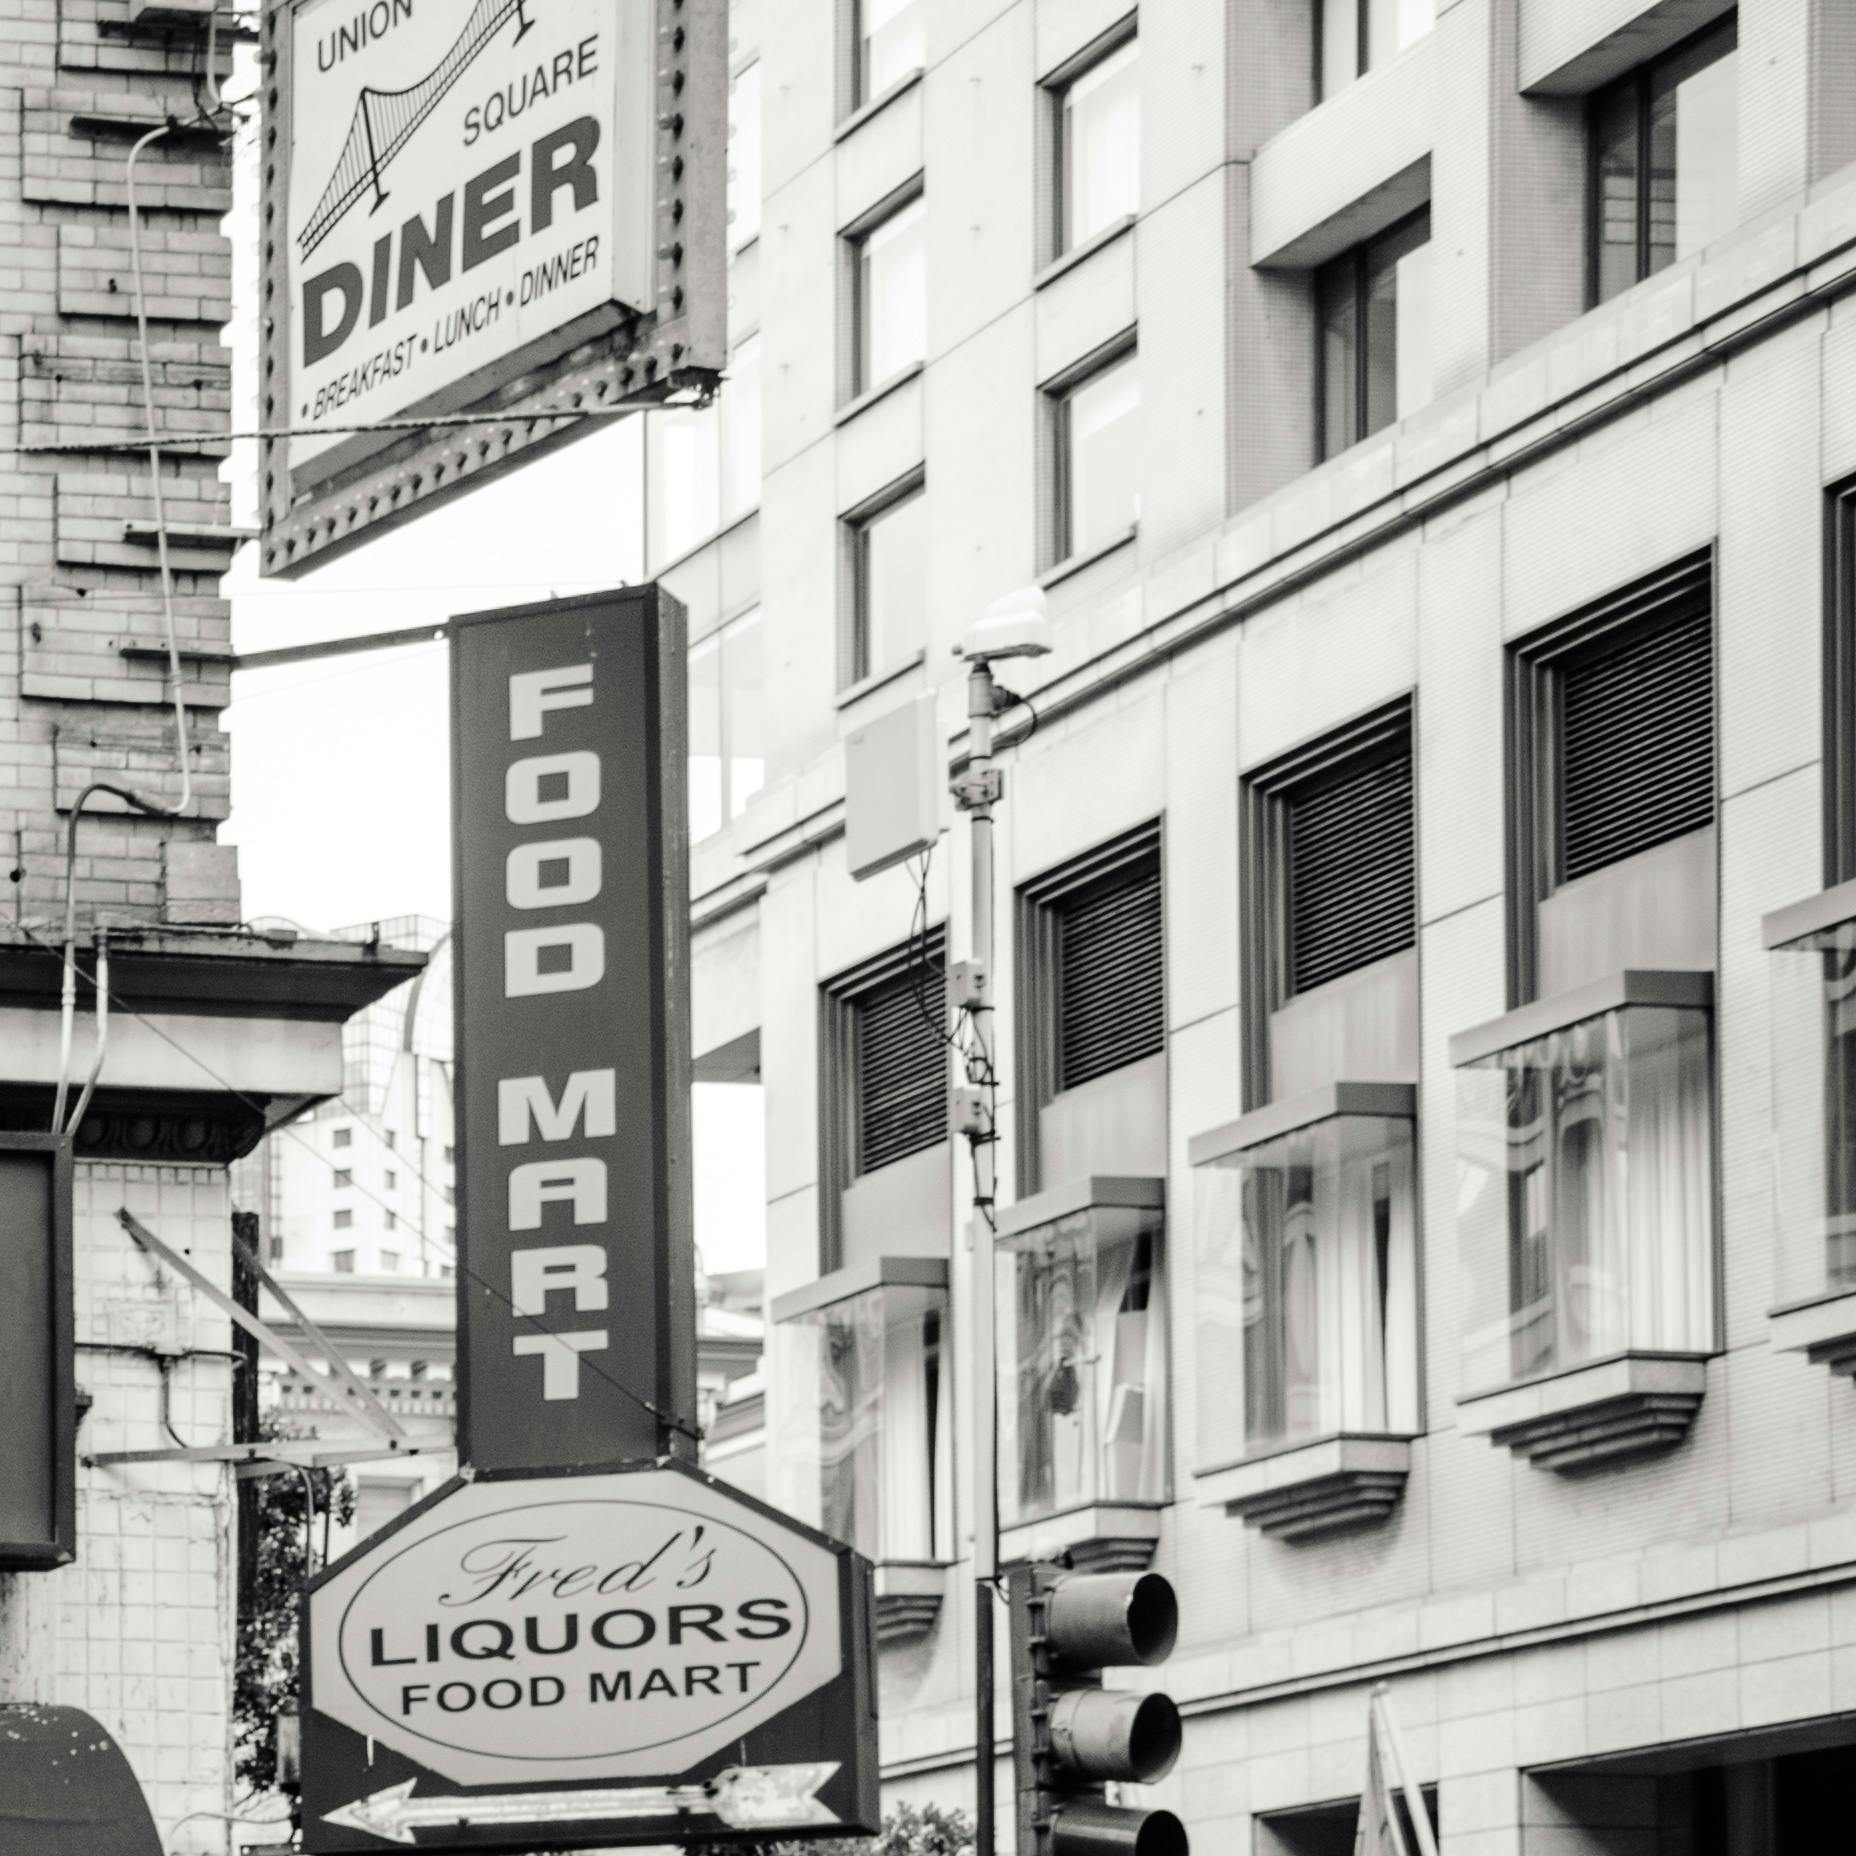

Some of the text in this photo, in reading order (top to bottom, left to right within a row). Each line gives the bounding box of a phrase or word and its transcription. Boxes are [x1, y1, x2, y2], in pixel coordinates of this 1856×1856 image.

[462, 34, 600, 147] SQUARE
[302, 114, 601, 368] DINER
[313, 235, 599, 422] BREAKFAST LUNCH DINNER
[498, 663, 616, 1401] FOOD MART
[438, 1525, 717, 1608] Fred's
[370, 1598, 792, 1667] LIQUORS
[401, 1661, 762, 1716] FOOD MART
